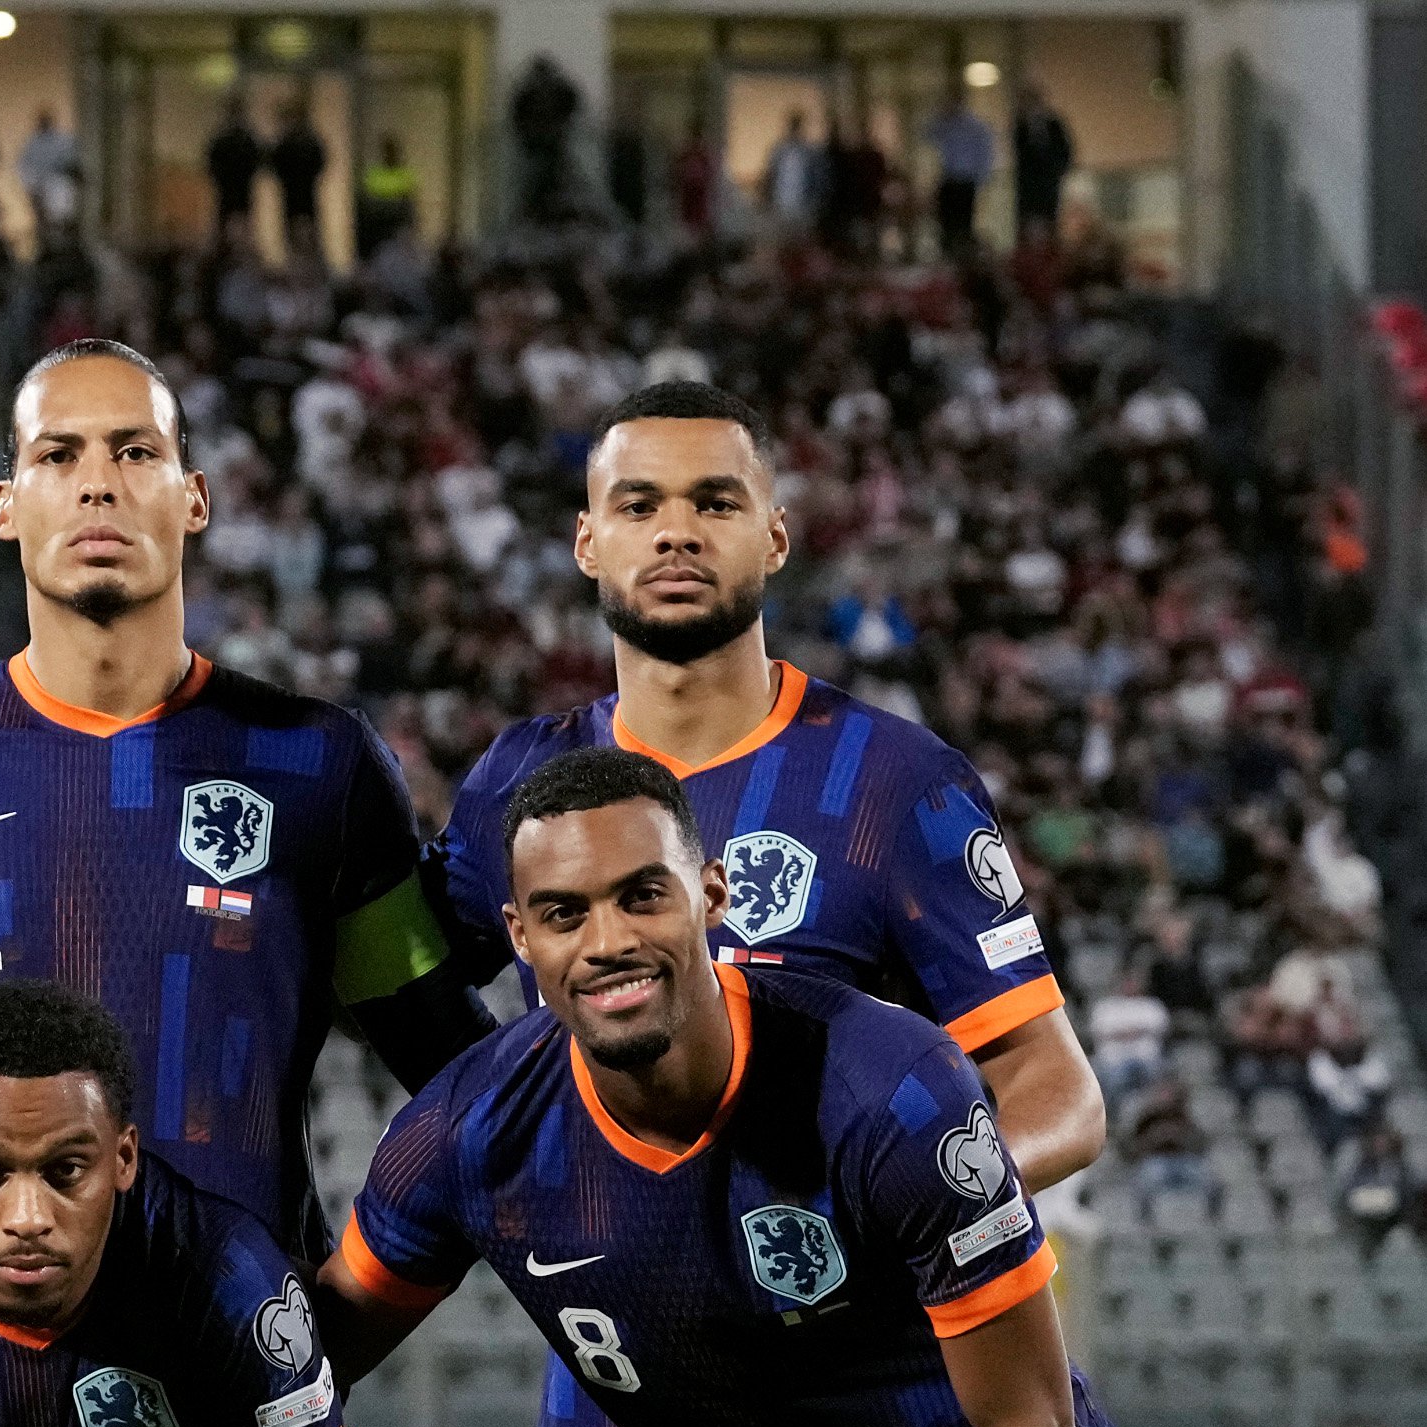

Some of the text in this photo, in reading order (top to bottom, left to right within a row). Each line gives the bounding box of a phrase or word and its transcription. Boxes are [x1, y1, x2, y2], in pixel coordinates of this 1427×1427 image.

[952, 1231, 971, 1244] UEFA
[954, 1210, 1025, 1255] FOUNDATION
[558, 1307, 642, 1393] 8
